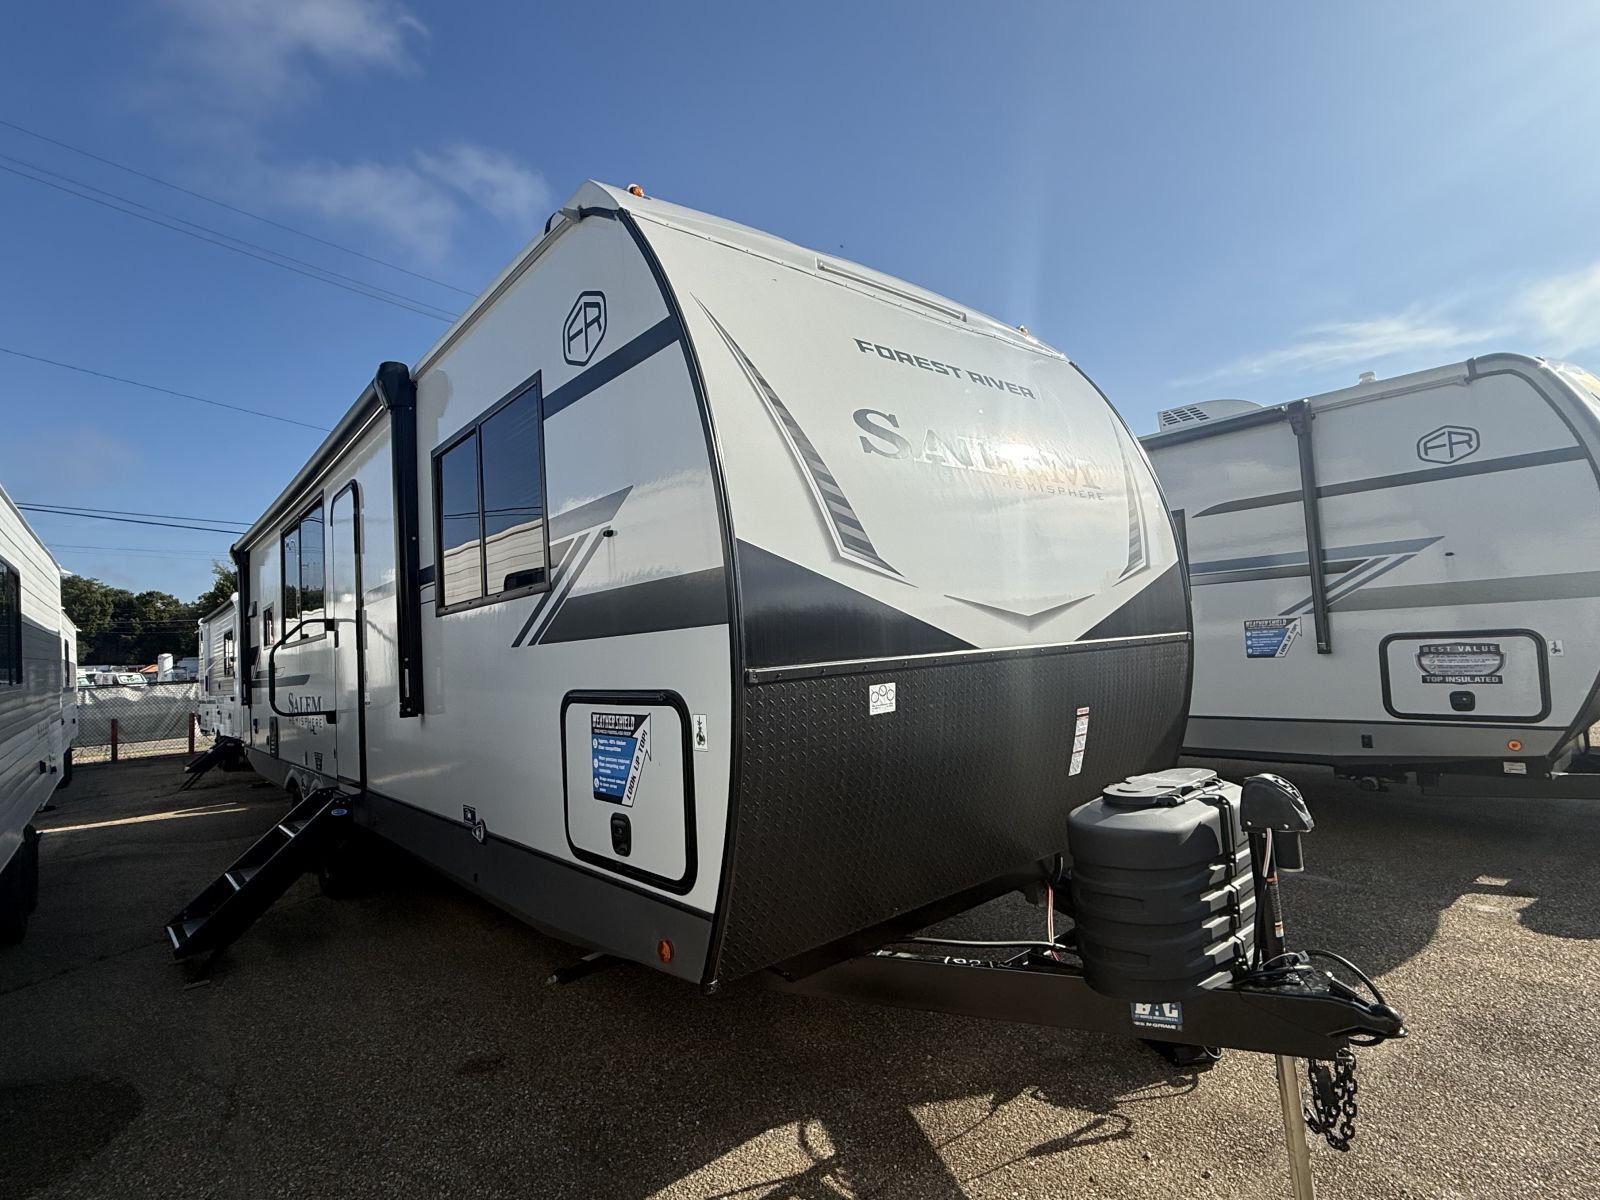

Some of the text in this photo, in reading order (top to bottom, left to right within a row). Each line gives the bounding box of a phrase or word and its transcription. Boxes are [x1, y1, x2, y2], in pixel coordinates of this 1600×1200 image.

[853, 338, 1036, 400] FOREST RIVER
[1001, 479, 1105, 501] HEMISPHERE
[1445, 675, 1499, 683] INSULATED
[288, 692, 322, 713] SALEM
[626, 775, 637, 800] LOOK
[633, 755, 640, 771] UP
